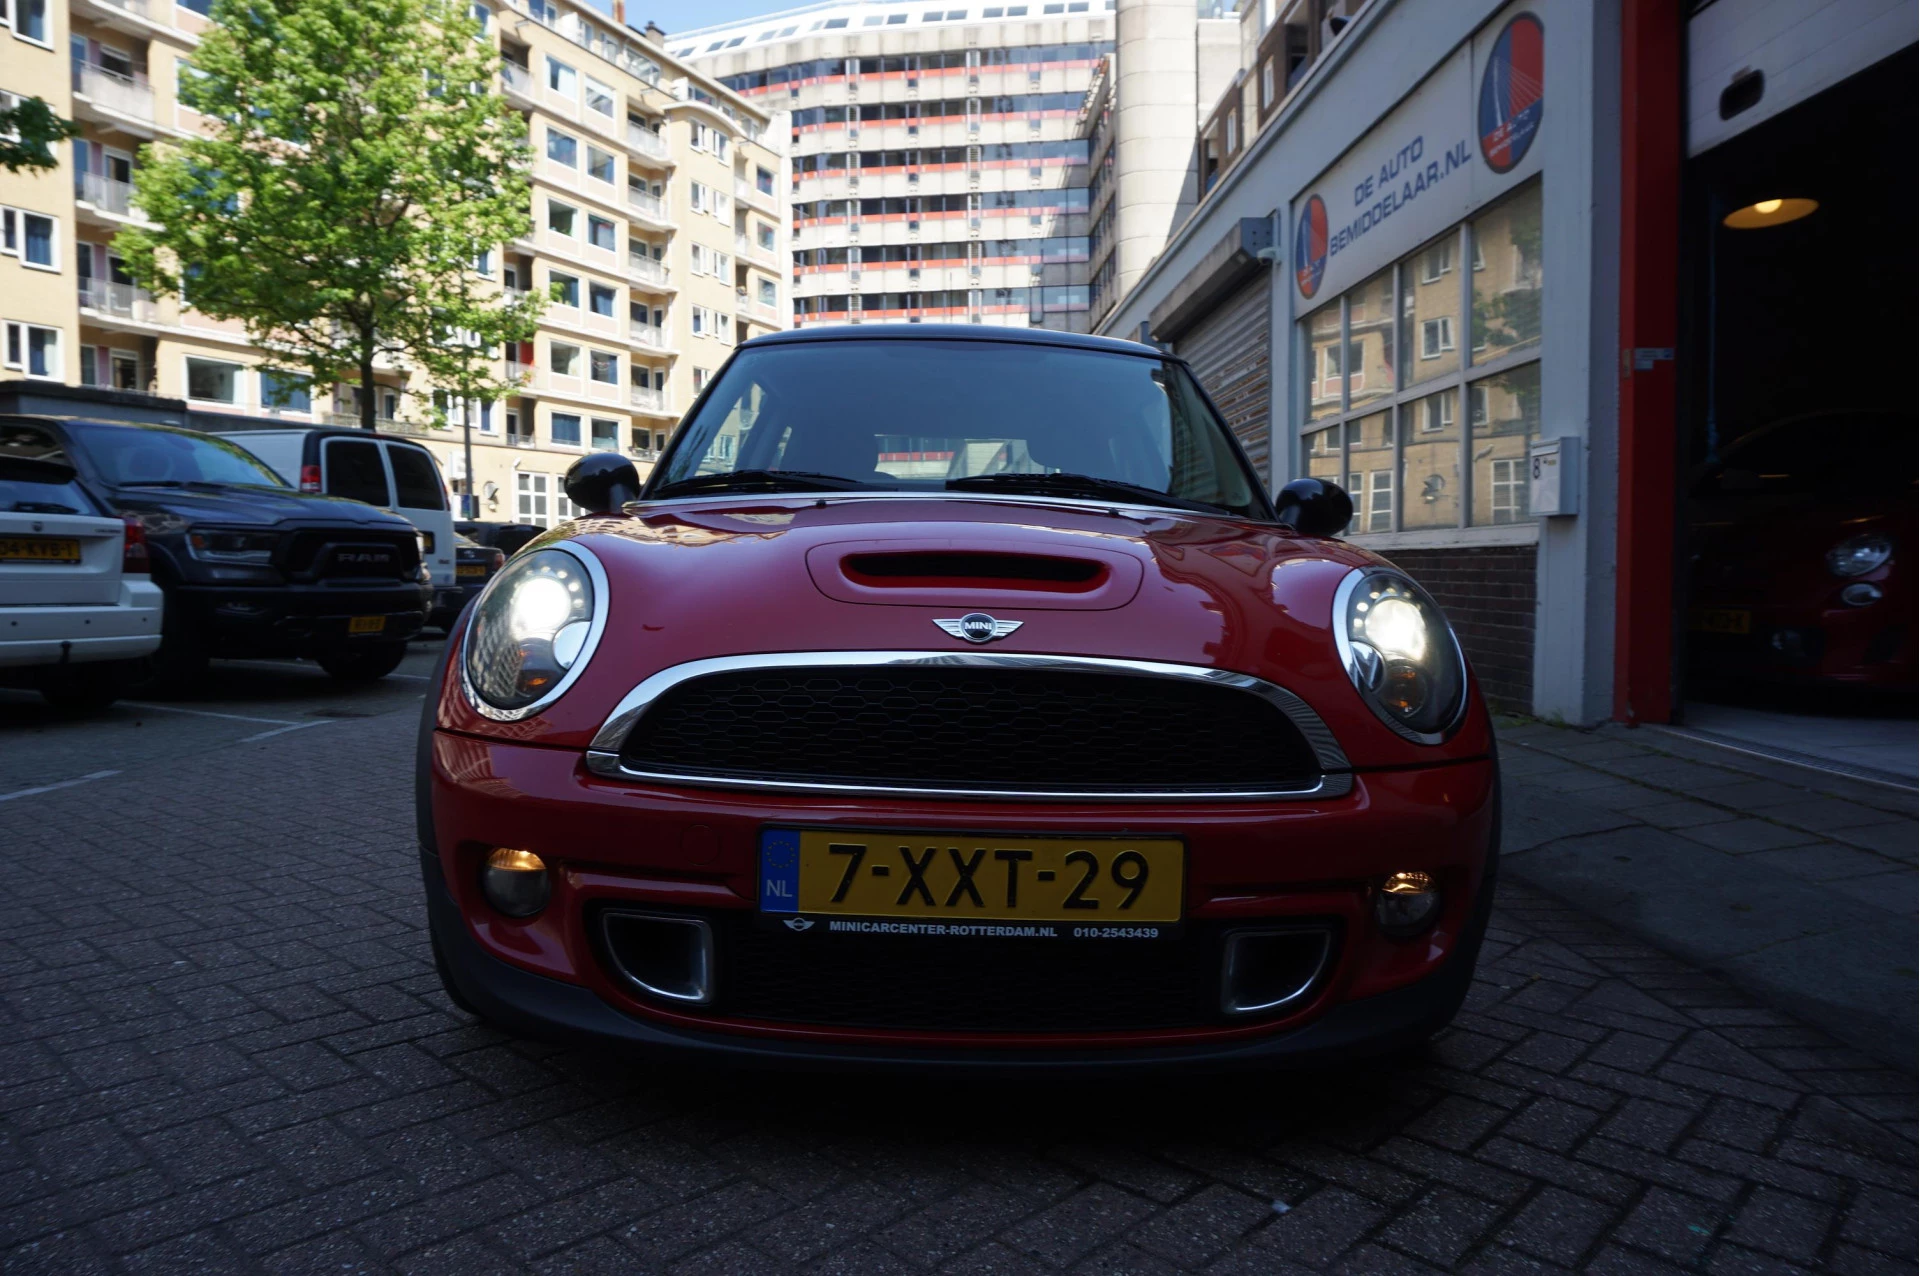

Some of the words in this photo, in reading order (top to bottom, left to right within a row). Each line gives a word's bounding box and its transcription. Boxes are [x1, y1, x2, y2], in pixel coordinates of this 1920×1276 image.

[1354, 175, 1373, 207] DE
[1377, 135, 1424, 190] AUTO
[1329, 140, 1473, 257] BEMIDDELAAR.NL
[1532, 457, 1541, 480] 8
[336, 553, 391, 563] RAM
[964, 621, 993, 631] MINI
[827, 842, 1151, 911] 7-XXT-29
[766, 879, 793, 899] NL
[829, 920, 1059, 938] MINICARCENTER-ROTTERDAM.NL
[1073, 926, 1160, 939] 010-2543439
